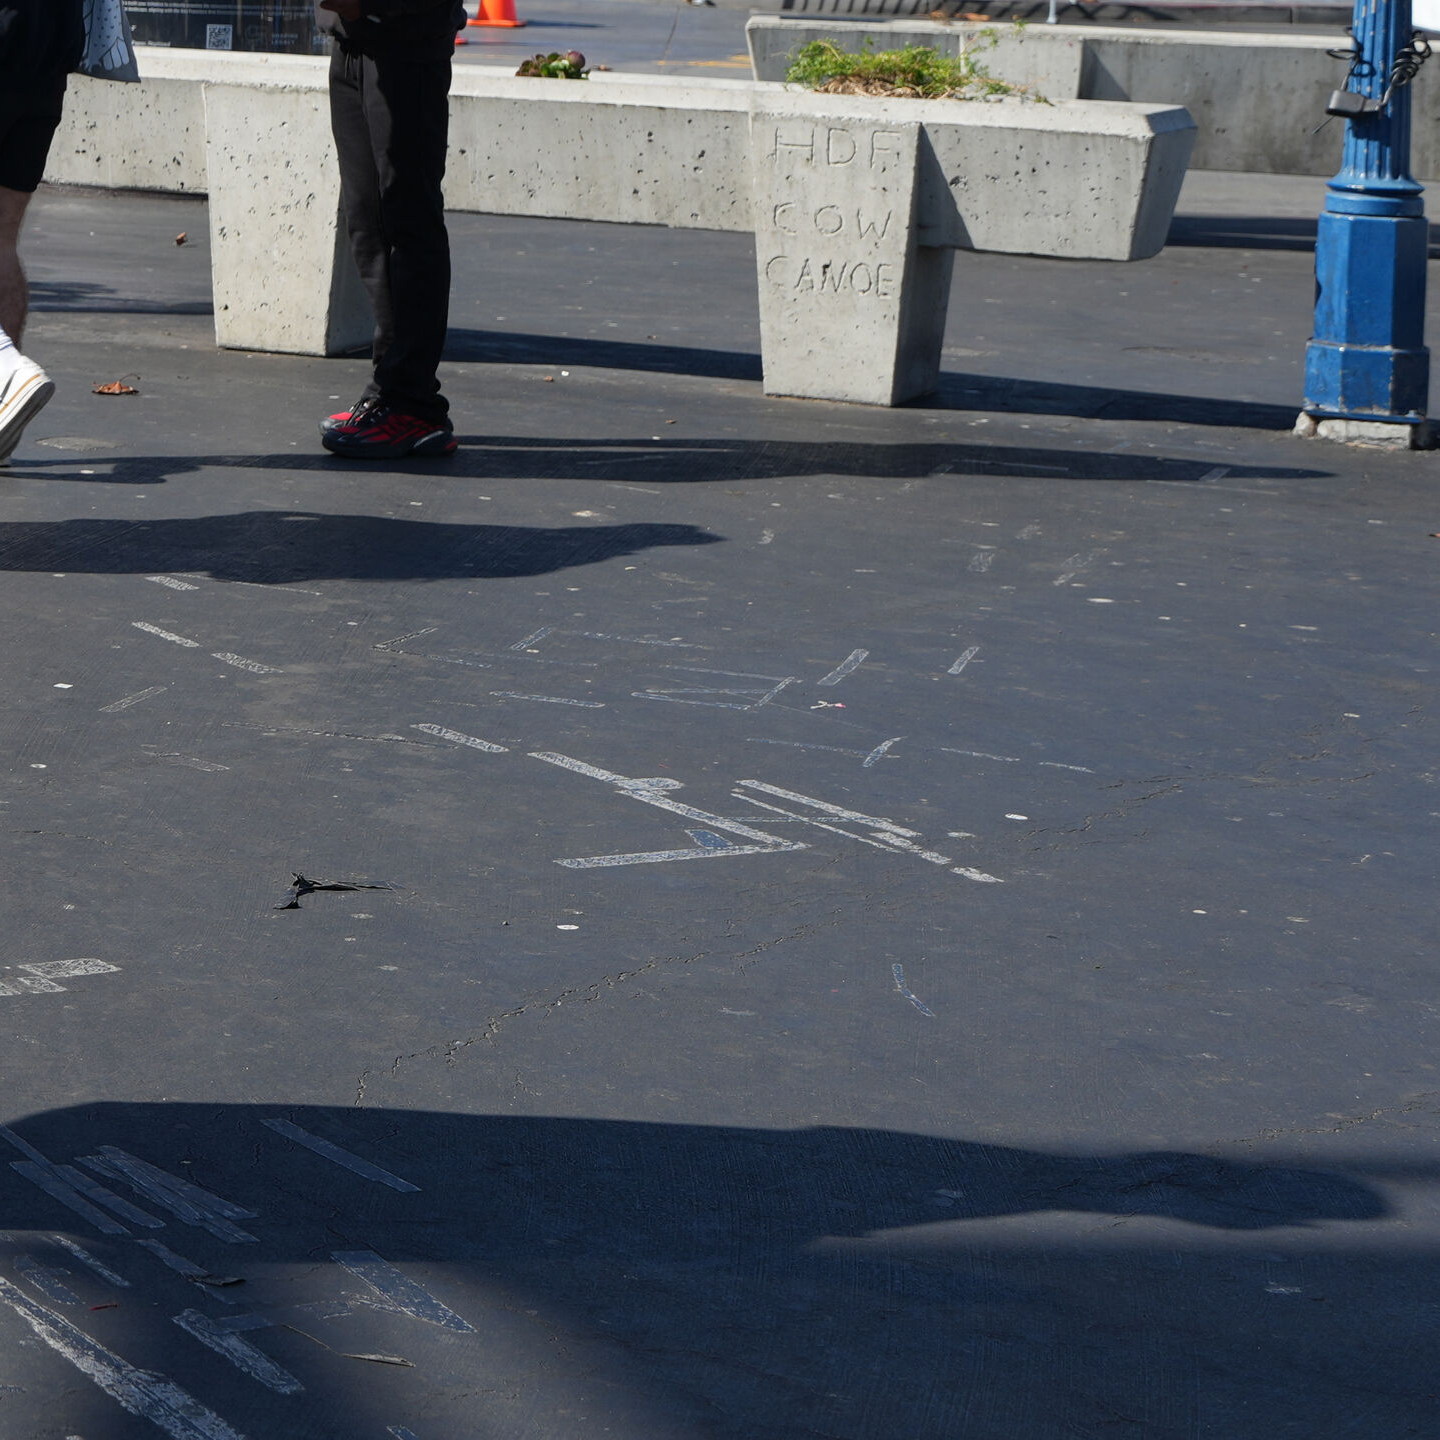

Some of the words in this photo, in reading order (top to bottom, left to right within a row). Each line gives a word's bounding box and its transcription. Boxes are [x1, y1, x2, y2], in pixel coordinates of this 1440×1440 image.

[773, 127, 902, 169] HDF
[773, 201, 893, 241] COW
[765, 255, 894, 299] CANOE
